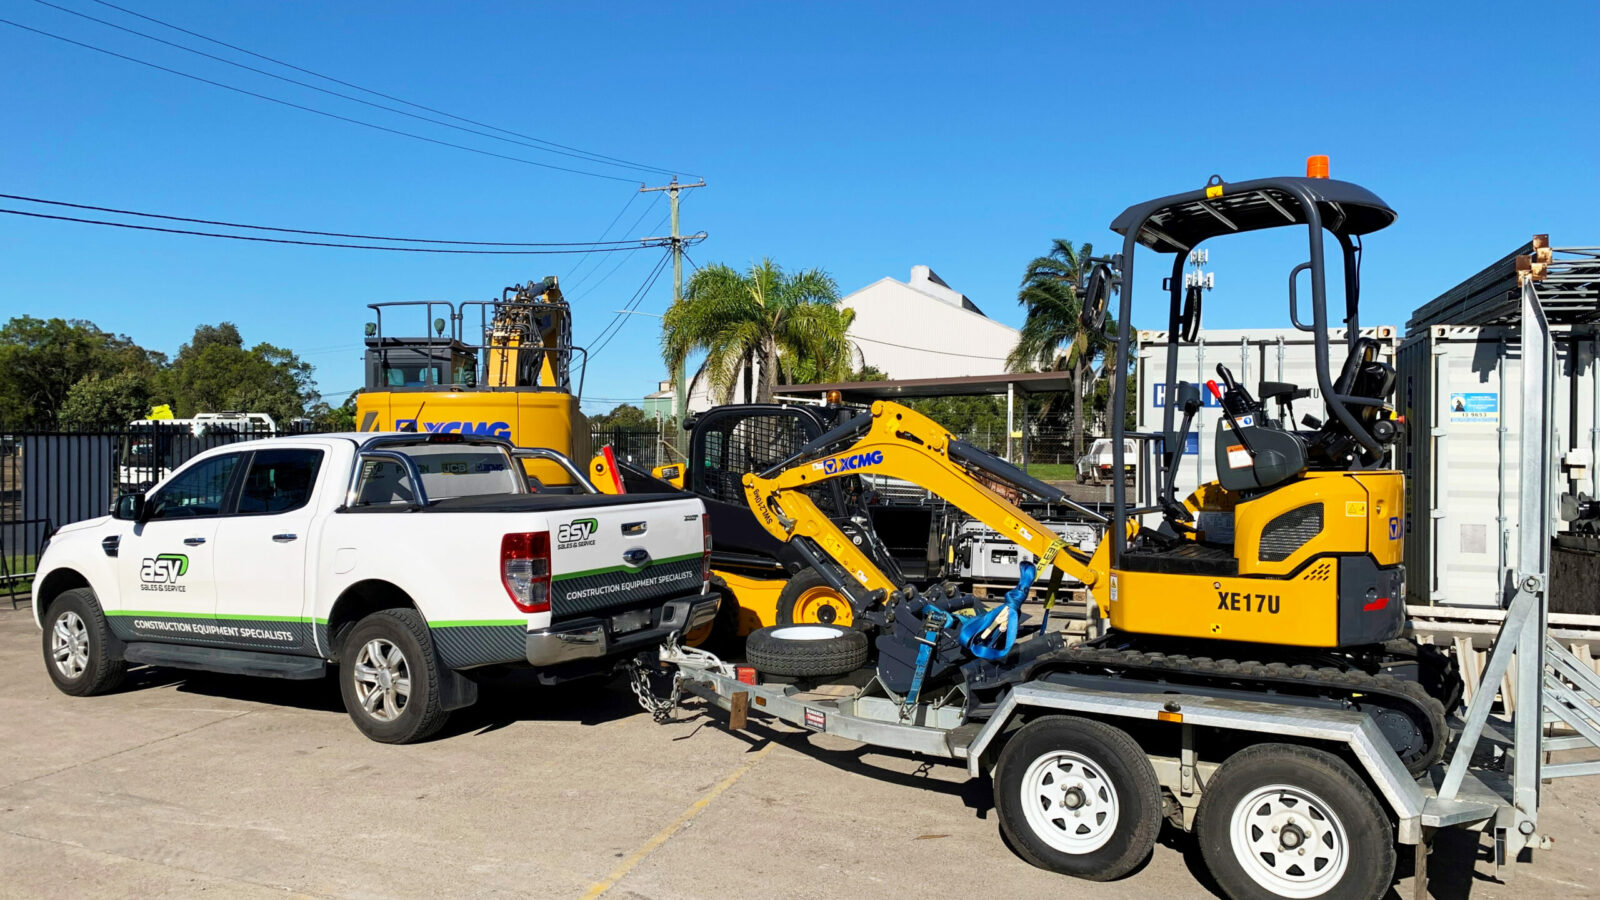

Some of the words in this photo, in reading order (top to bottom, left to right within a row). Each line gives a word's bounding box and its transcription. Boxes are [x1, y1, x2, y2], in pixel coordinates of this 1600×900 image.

[443, 463, 467, 473] JCB
[839, 450, 884, 472] XCMG
[164, 584, 186, 592] SERVICE
[566, 583, 620, 601] CONSTRUCTION
[621, 577, 657, 591] EQUIPMENT
[658, 570, 693, 584] SPECIALISTS
[1217, 591, 1280, 614] XE17U
[133, 619, 192, 632] CONSTRUCTION
[192, 623, 239, 637] EQUIPMENT
[239, 627, 294, 641] SPECIALISTS
